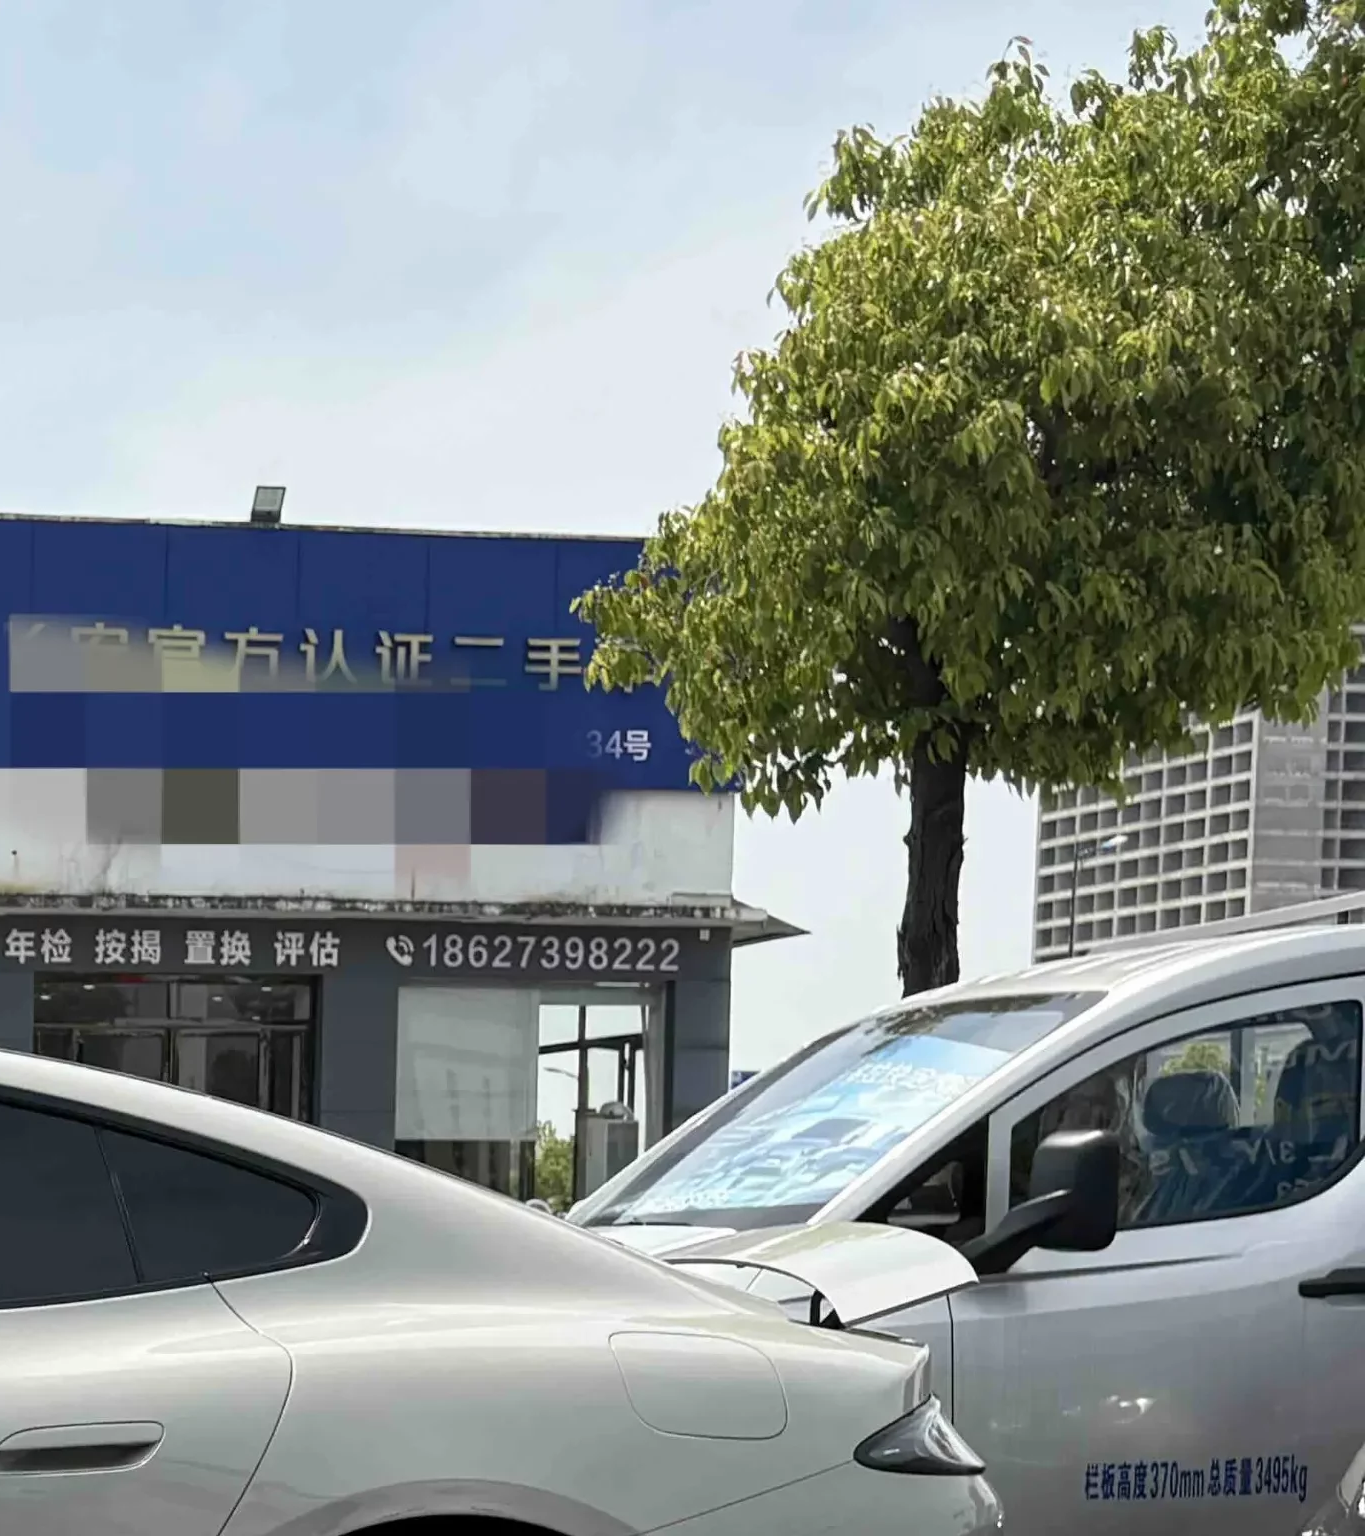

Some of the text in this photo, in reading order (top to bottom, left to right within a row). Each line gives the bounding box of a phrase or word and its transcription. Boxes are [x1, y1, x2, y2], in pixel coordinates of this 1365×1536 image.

[5, 929, 72, 964] 年检
[95, 929, 161, 964] 按揭
[184, 930, 251, 966] 置换
[274, 931, 340, 967] 评估
[422, 933, 680, 971] 18627398222
